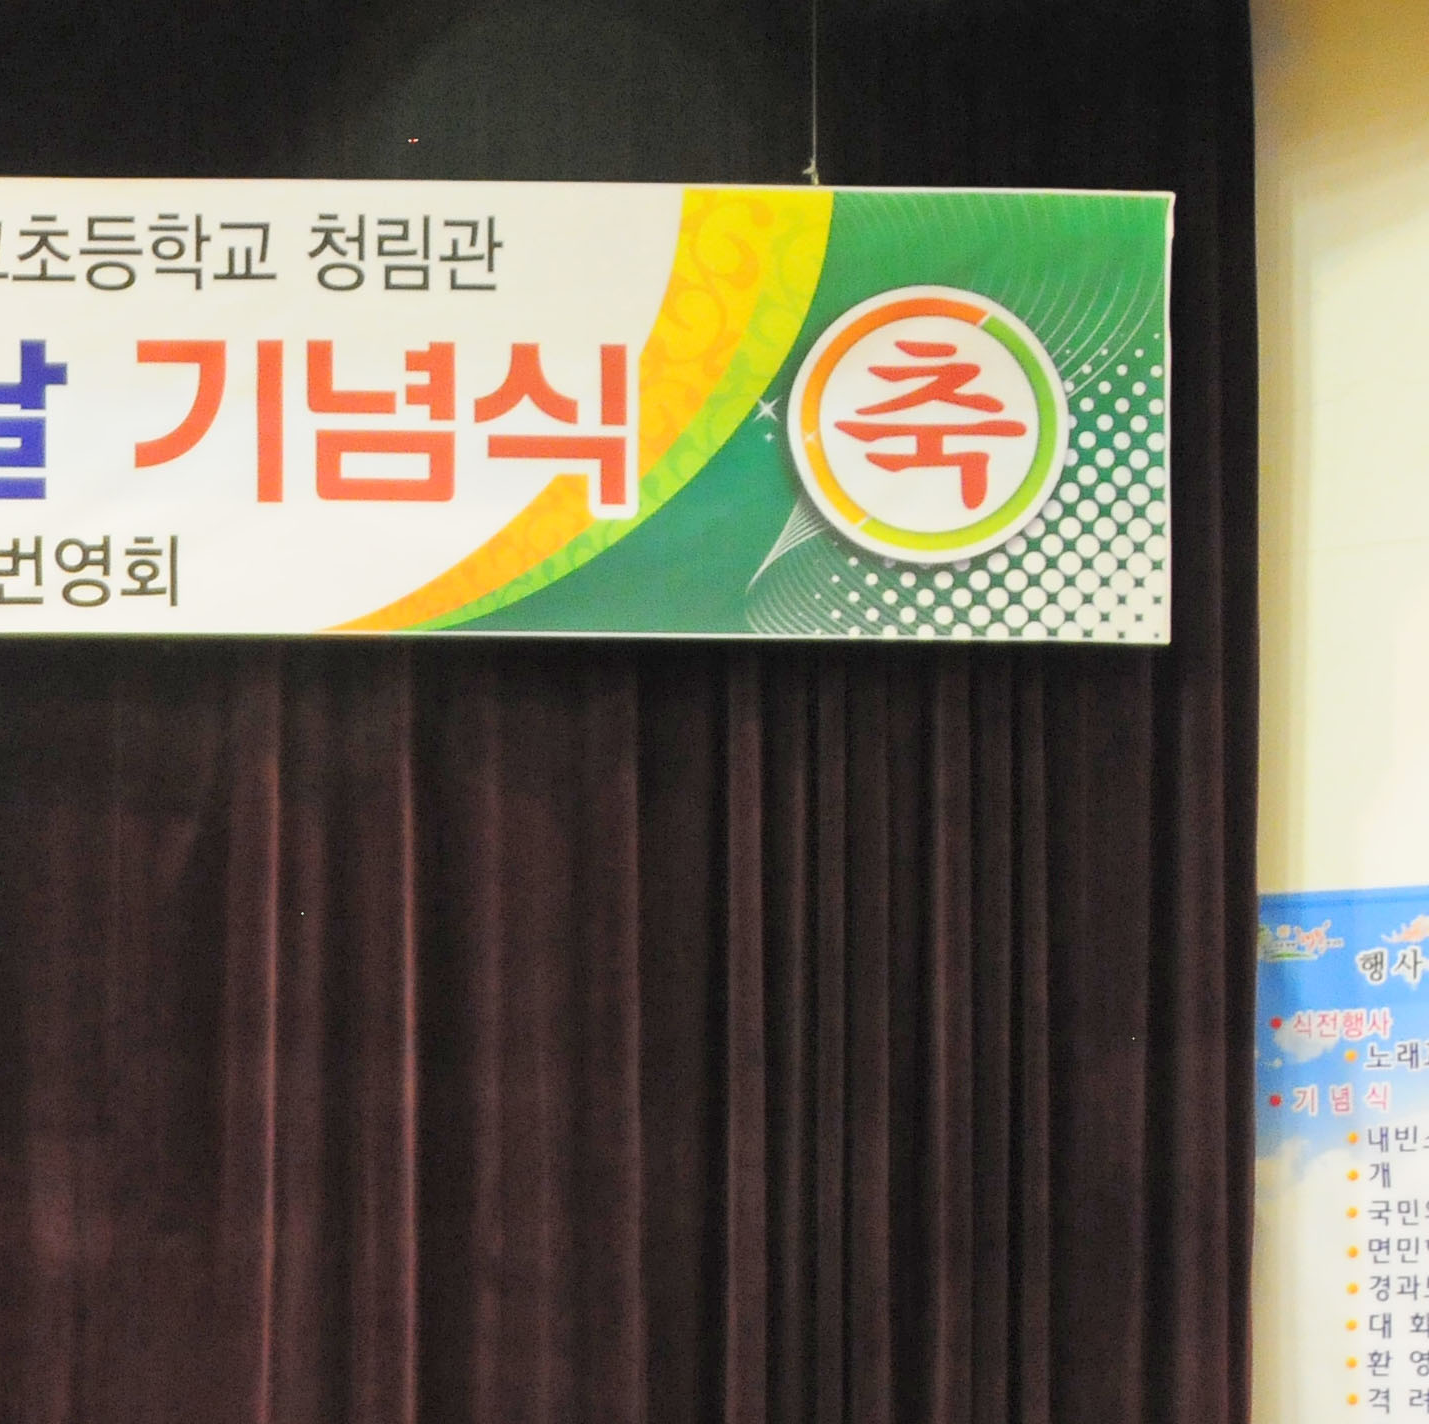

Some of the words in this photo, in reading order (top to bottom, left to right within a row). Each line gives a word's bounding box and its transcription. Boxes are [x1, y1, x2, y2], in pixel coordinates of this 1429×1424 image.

[307, 212, 505, 293] 청림관
[133, 339, 627, 506] 기념식
[833, 340, 1028, 511] 축
[1367, 1042, 1429, 1070] 노래
[1368, 1126, 1429, 1152] 내빈
[1368, 1199, 1429, 1226] 국민
[1368, 1236, 1429, 1264] 면민
[1369, 1274, 1429, 1302] 경과
